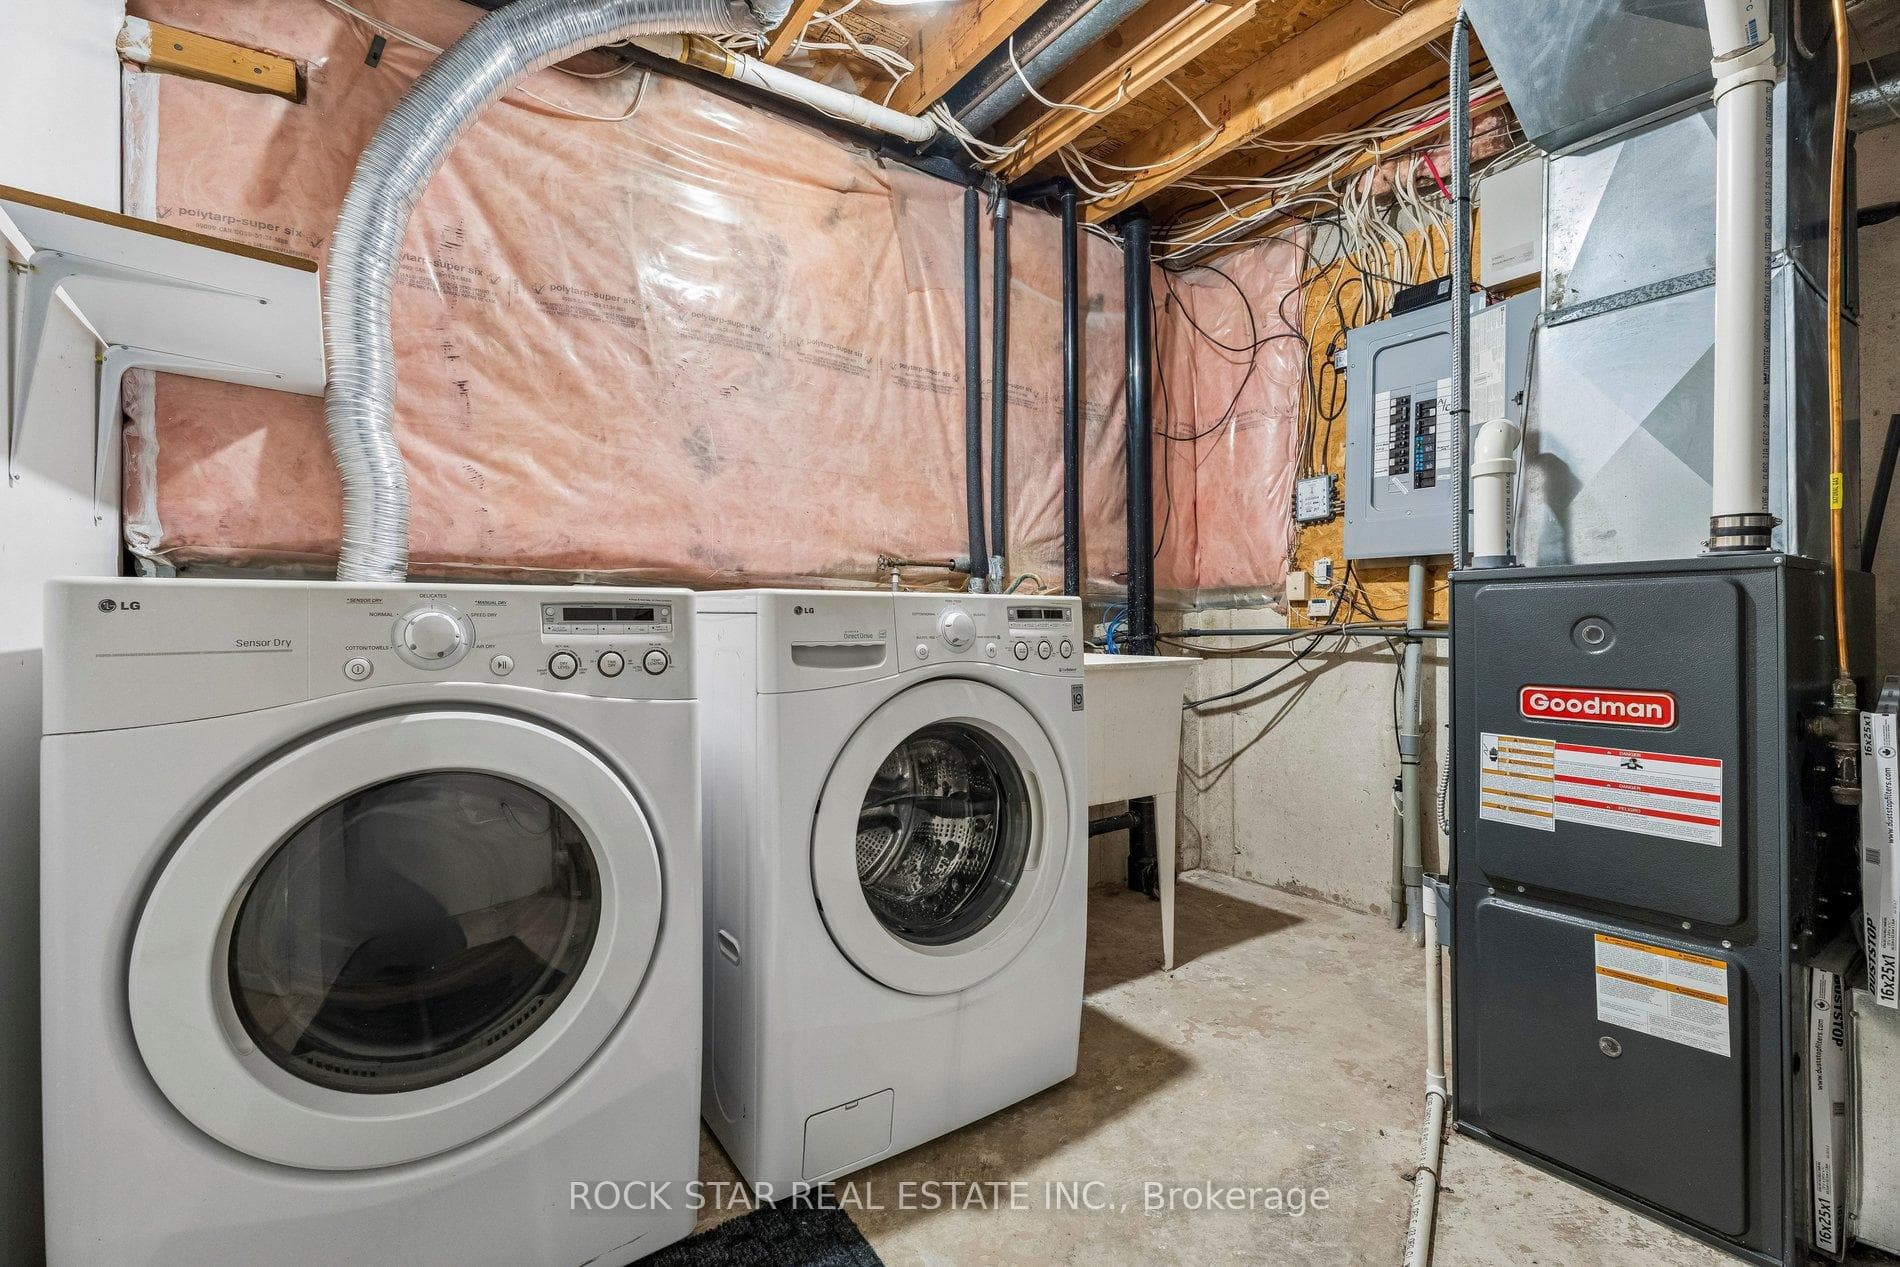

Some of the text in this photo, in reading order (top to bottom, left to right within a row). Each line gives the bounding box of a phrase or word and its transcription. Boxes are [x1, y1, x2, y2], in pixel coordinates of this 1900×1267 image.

[178, 206, 303, 238] polytarp-super six
[550, 284, 621, 302] polytarp-super
[120, 601, 141, 610] LG
[236, 638, 292, 648] Sensor Dry
[1529, 692, 1663, 719] Goodman
[1863, 716, 1873, 757] 16x25x1
[1884, 767, 1894, 844] www.duststopfilters.com
[1866, 919, 1877, 996] DUSTSTOP
[1880, 954, 1895, 1001] 16x25x1
[1815, 1019, 1824, 1091] www.duststopfilters.com
[1817, 1198, 1832, 1244] 16x25x1
